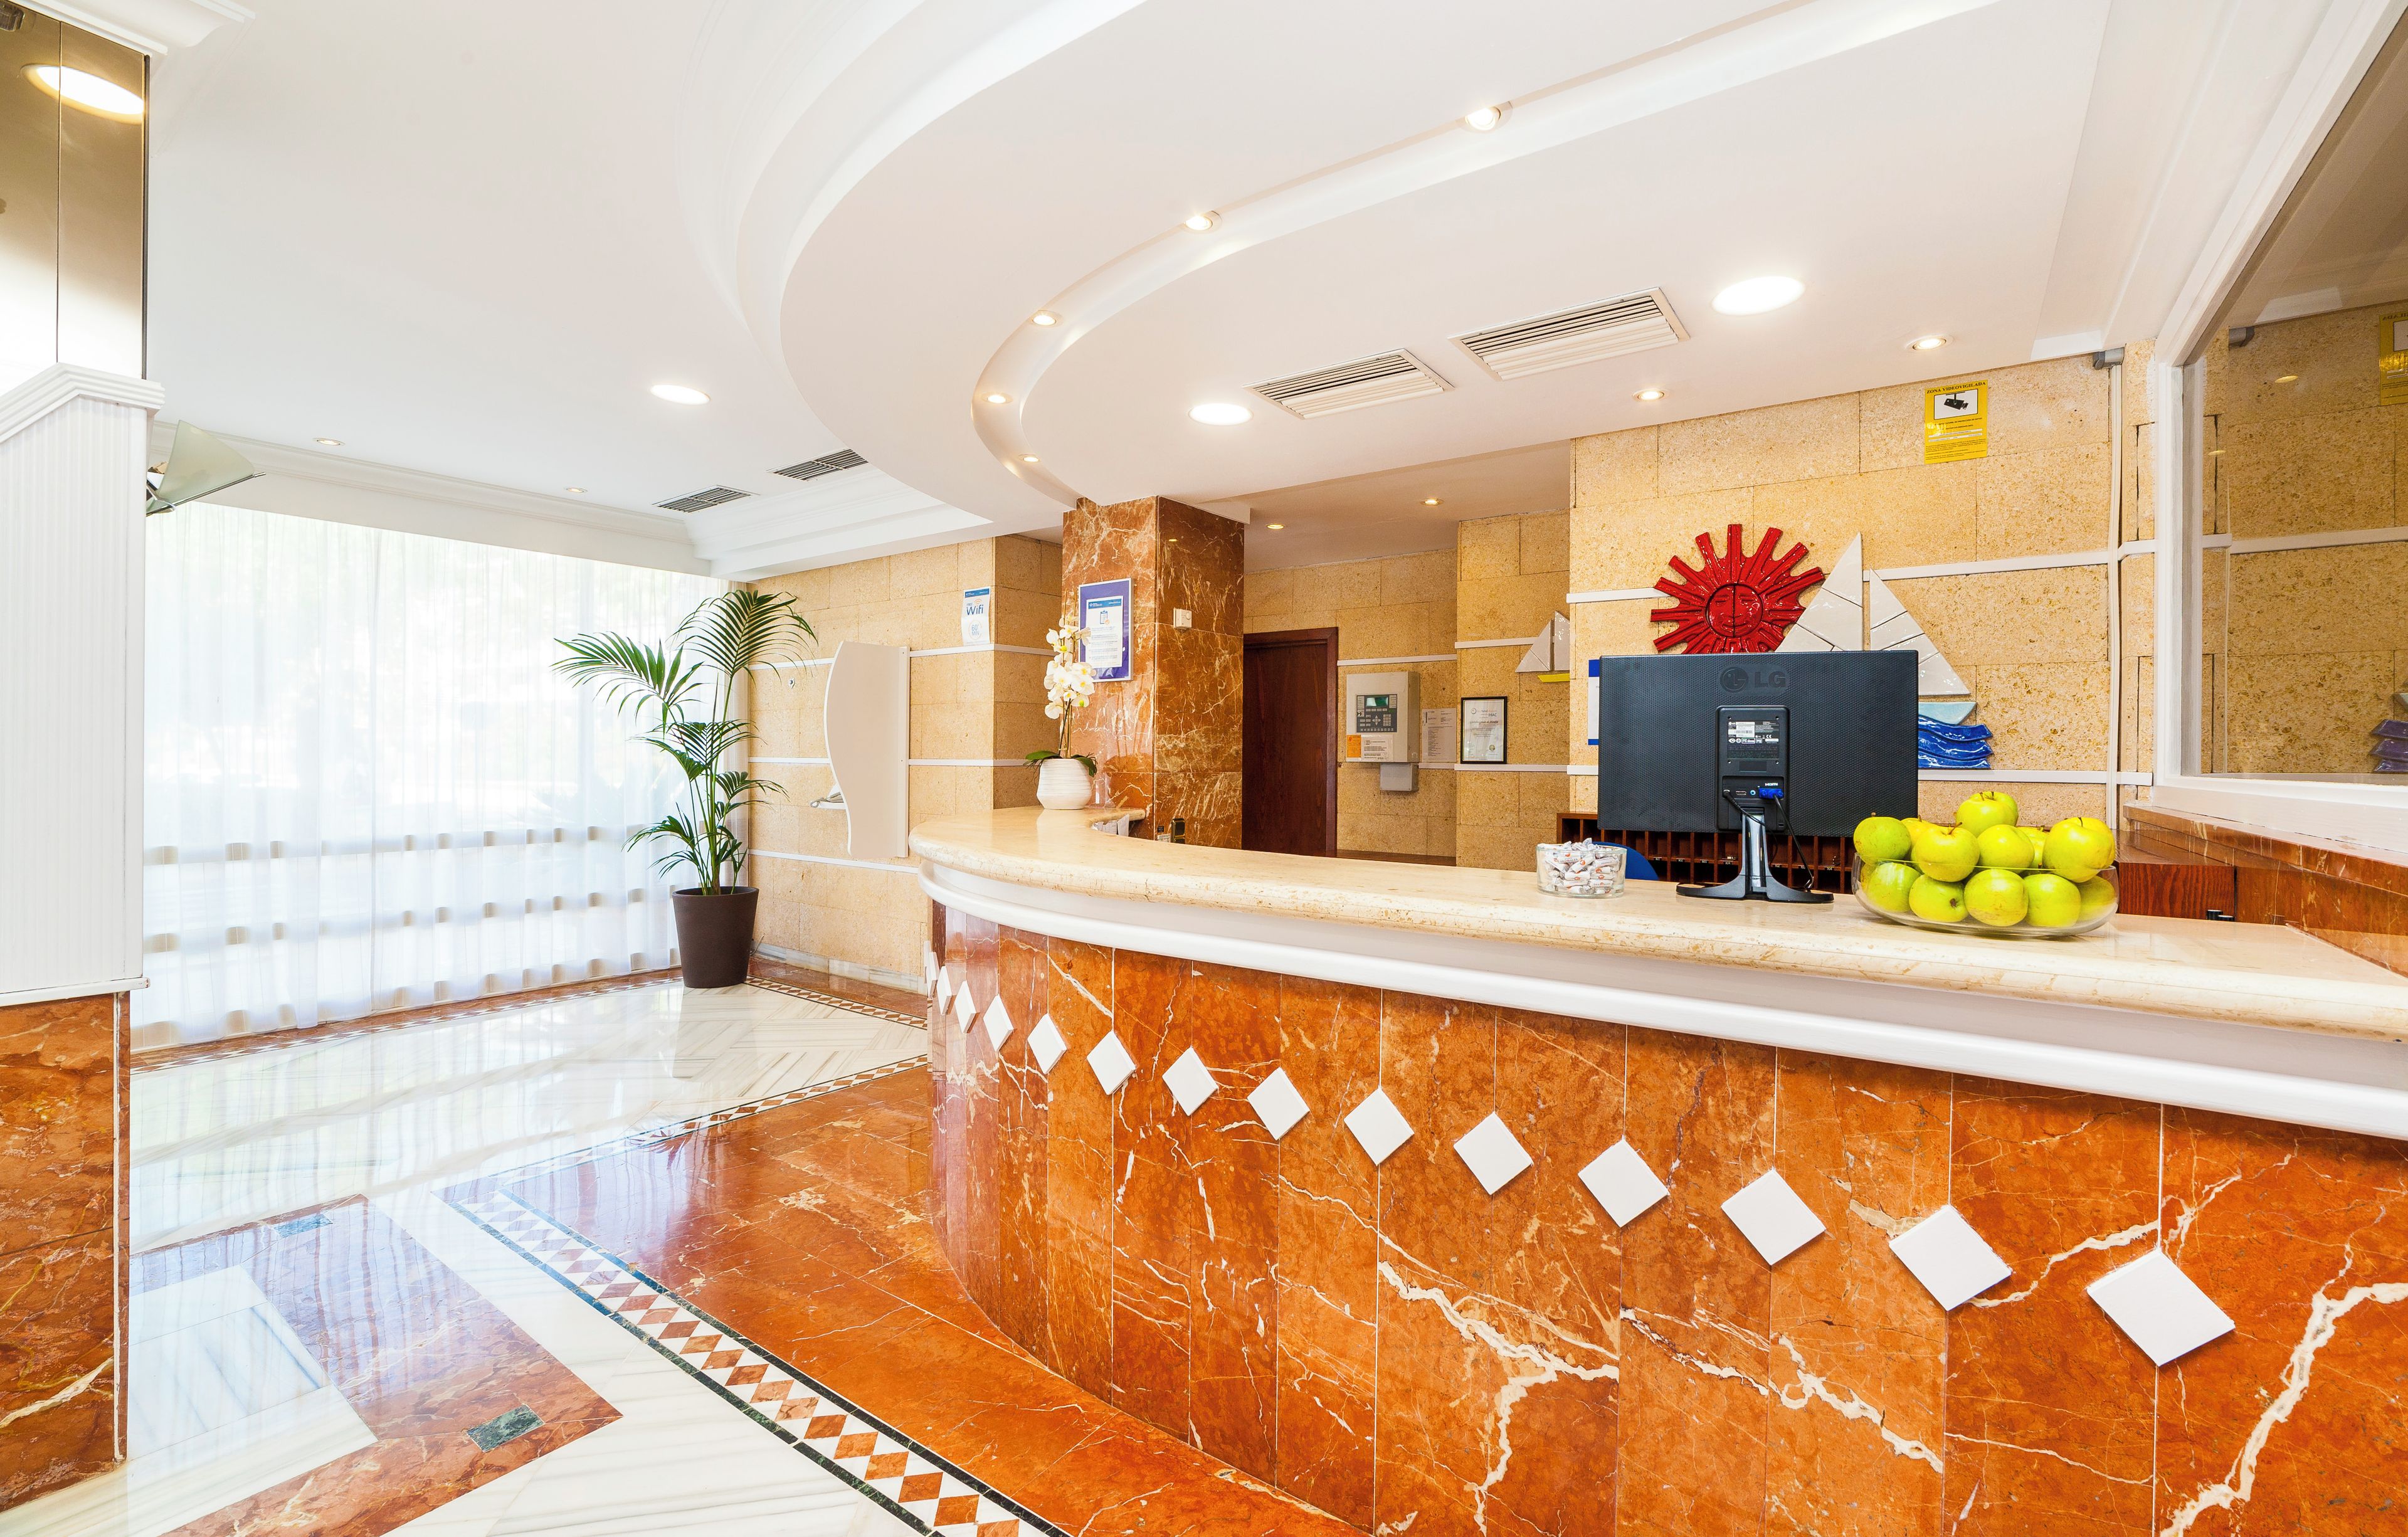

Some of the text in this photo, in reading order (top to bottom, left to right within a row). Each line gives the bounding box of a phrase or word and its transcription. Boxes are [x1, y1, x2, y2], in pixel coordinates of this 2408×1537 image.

[1943, 381, 1986, 391] VIDEOVIGILADA
[966, 605, 984, 615] Wifi
[1754, 671, 1787, 688] LG
